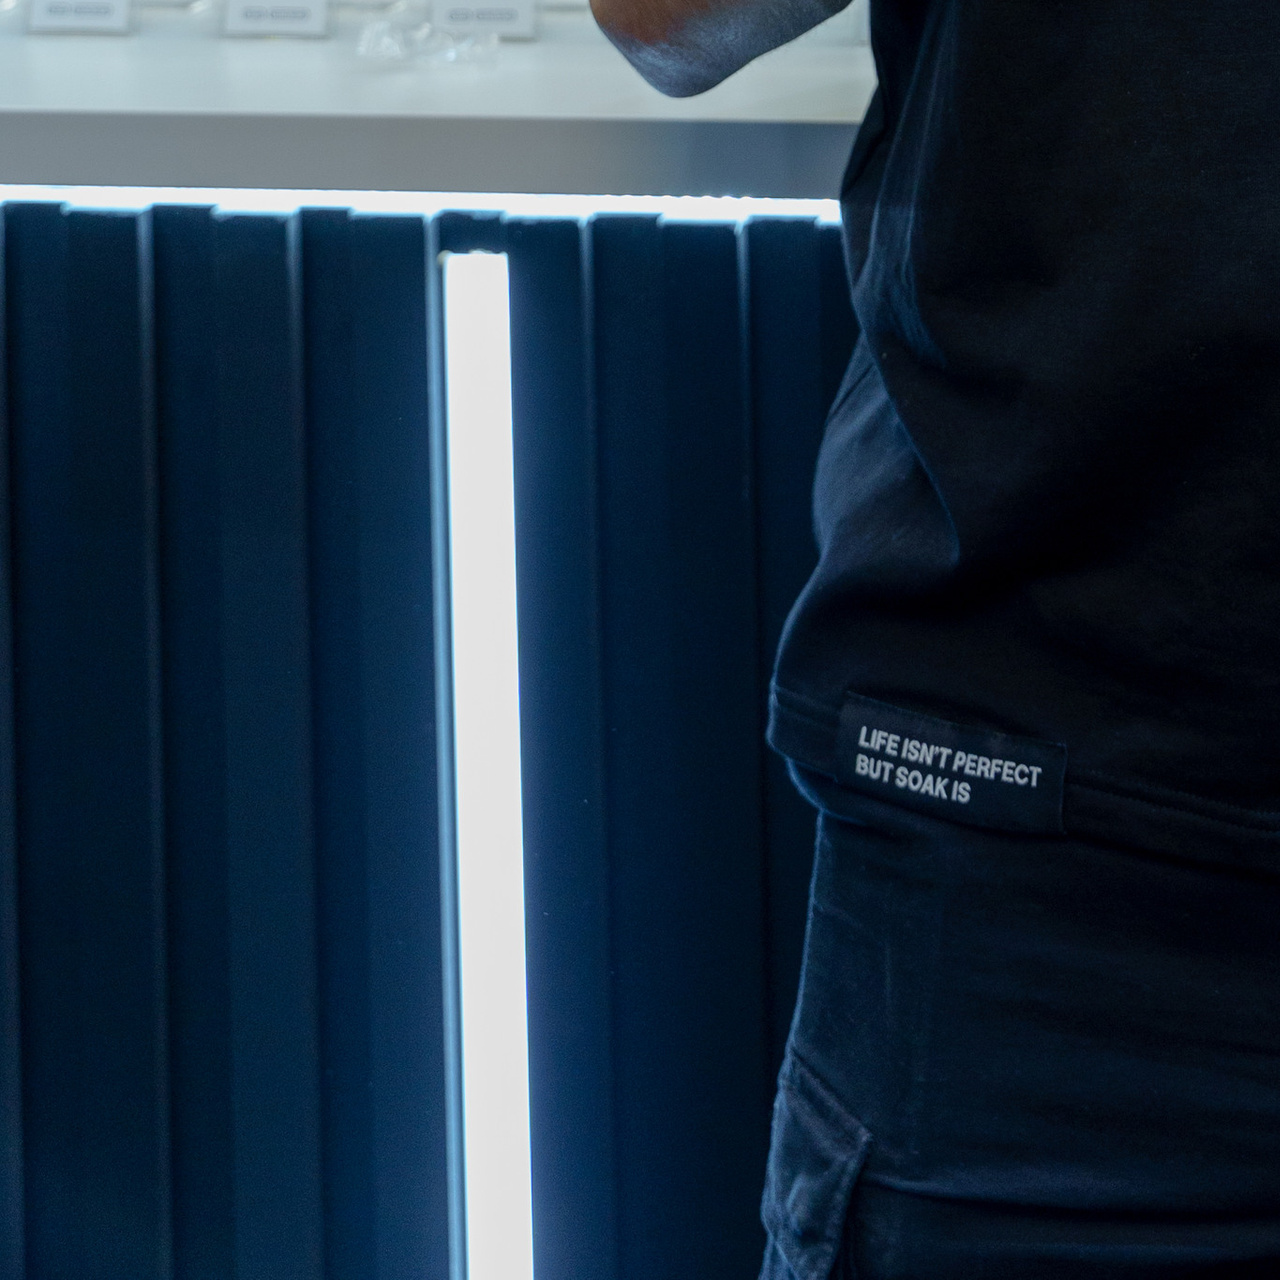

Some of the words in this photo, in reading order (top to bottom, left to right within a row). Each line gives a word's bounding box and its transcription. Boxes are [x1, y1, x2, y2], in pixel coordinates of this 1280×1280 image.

[855, 754, 895, 782] BUT
[895, 765, 949, 800] SOAK
[951, 780, 972, 805] IS
[858, 726, 900, 756] LIFE
[901, 738, 952, 770] ISN'T
[952, 751, 1042, 788] PERFECT
